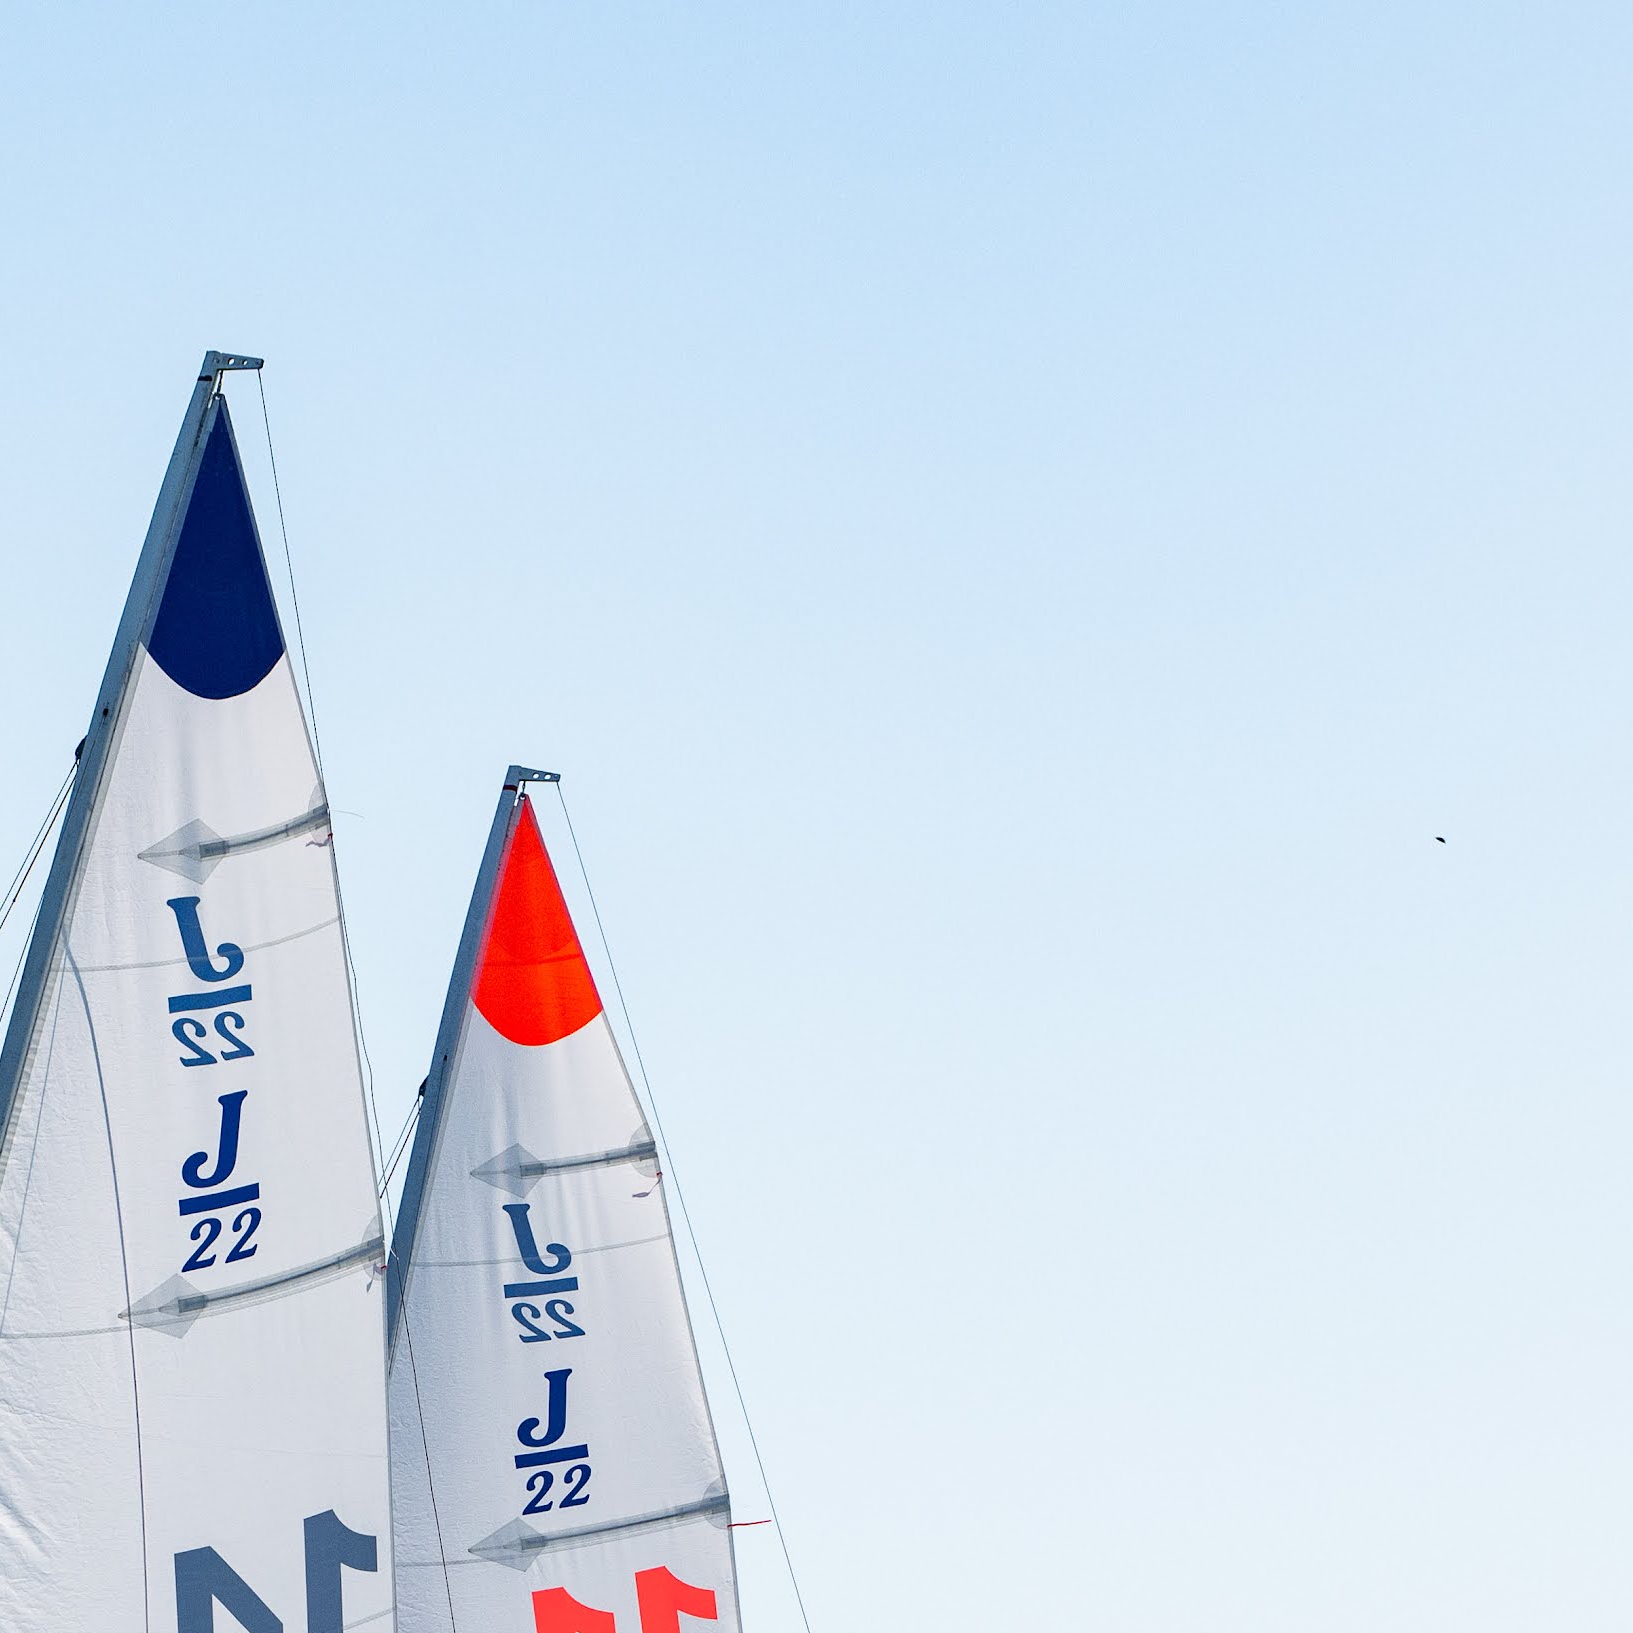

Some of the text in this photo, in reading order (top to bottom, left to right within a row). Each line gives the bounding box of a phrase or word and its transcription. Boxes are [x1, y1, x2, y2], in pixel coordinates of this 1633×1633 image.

[182, 1089, 248, 1188] J
[181, 1207, 262, 1273] 22
[517, 1368, 572, 1447] J
[522, 1464, 591, 1515] 22
